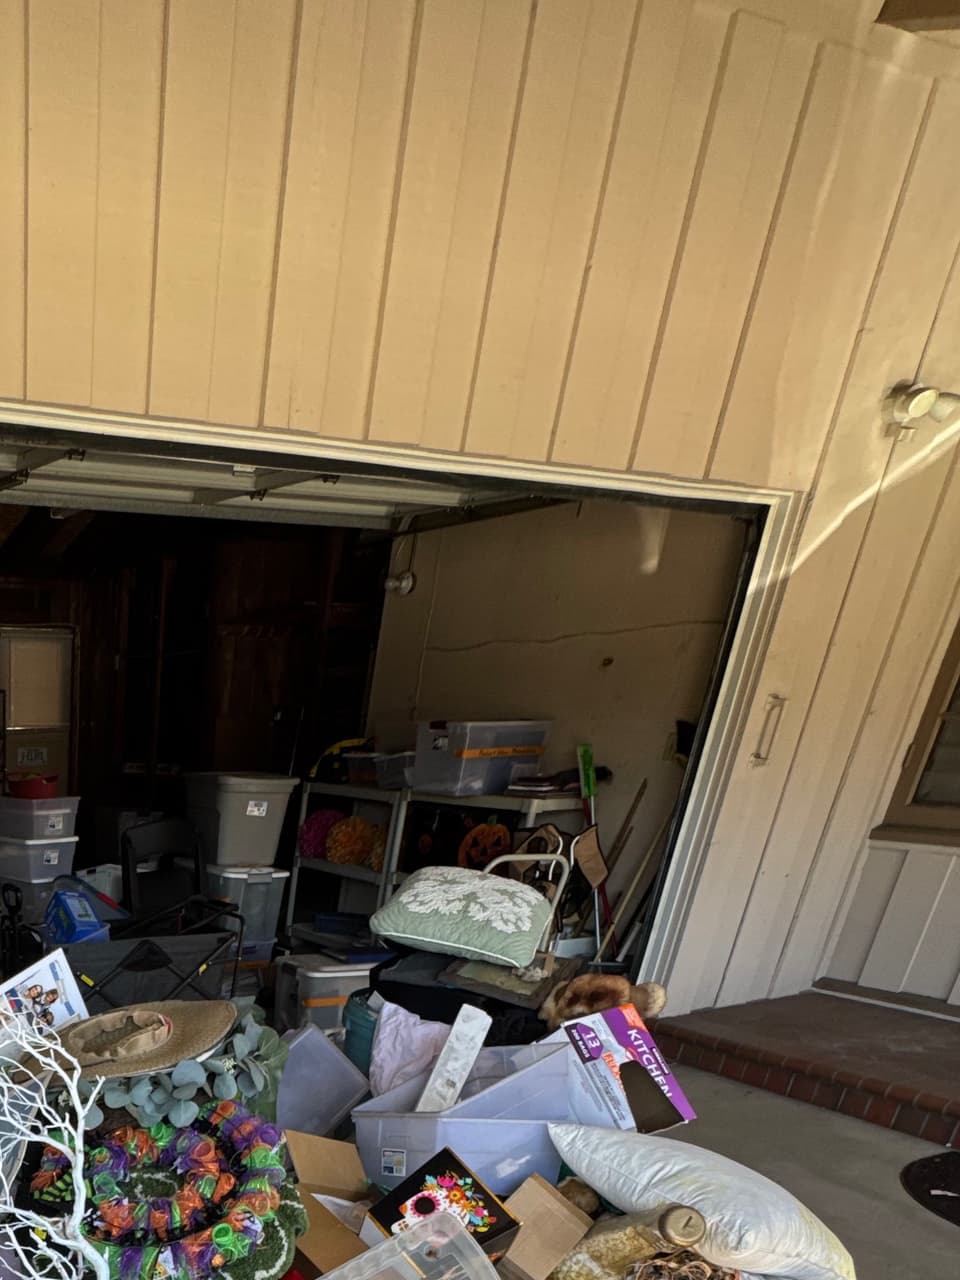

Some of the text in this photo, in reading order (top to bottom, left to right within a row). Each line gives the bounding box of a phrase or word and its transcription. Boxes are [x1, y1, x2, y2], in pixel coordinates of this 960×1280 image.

[585, 1031, 600, 1048] 13
[578, 1040, 591, 1058] BAGS
[627, 1029, 673, 1098] KITCHEN
